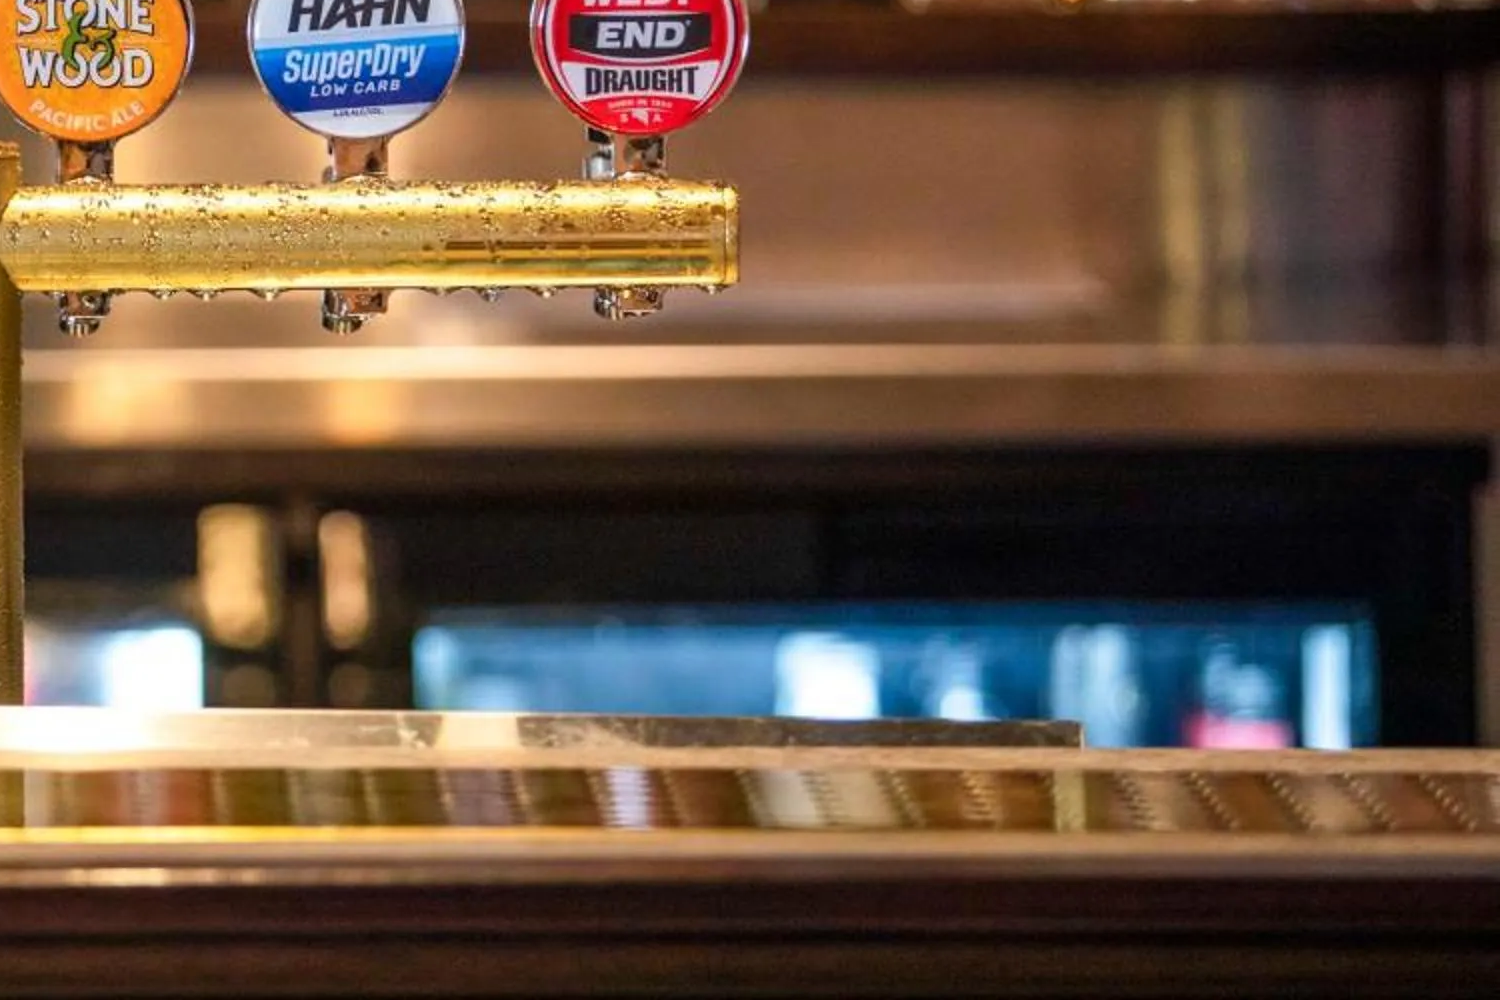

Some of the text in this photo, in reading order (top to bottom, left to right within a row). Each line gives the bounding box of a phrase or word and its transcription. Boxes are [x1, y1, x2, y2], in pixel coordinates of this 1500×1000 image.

[595, 20, 686, 50] END
[18, 47, 155, 88] WOOD
[282, 42, 427, 85] SuperDry
[310, 78, 402, 97] LOW CARB
[584, 66, 700, 96] DRAUGHT
[29, 99, 146, 133] PACIFIC ALE
